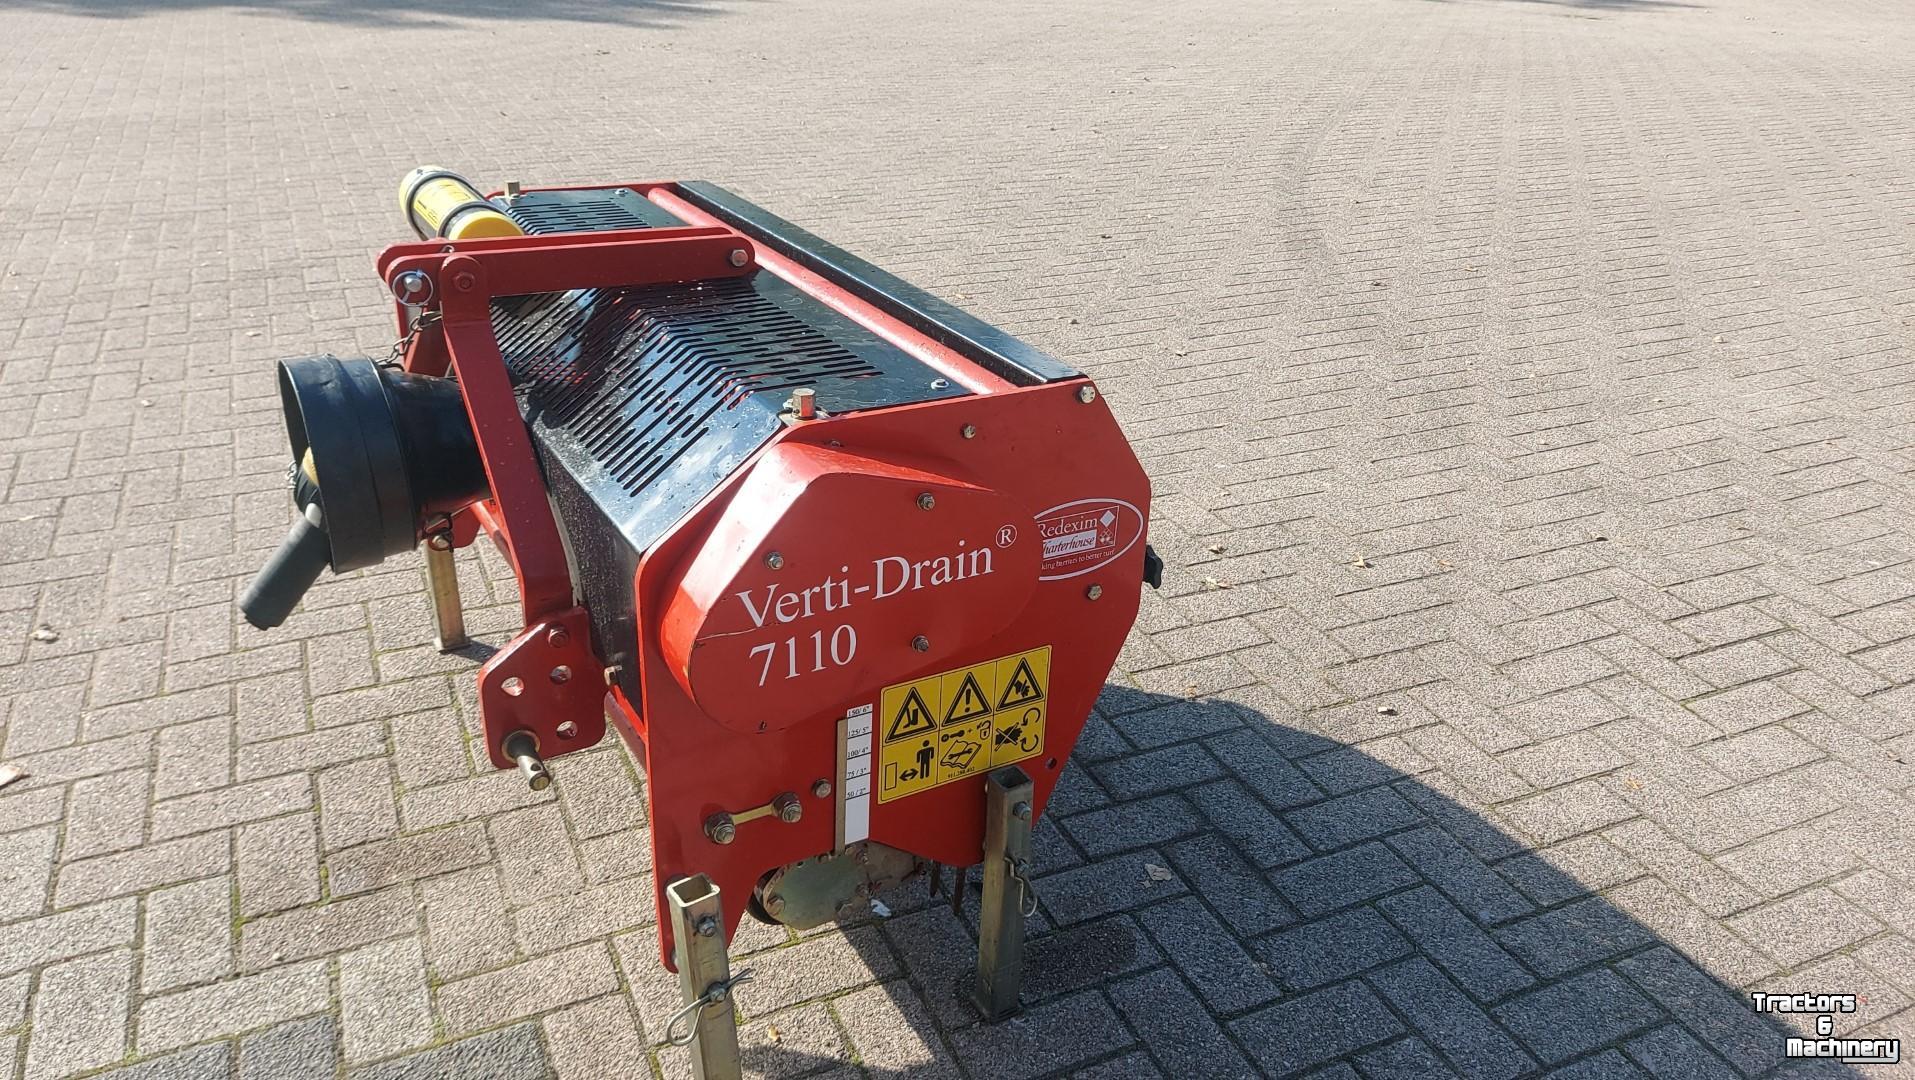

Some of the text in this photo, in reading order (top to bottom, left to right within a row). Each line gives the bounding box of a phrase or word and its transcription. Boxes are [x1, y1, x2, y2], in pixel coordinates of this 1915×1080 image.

[1038, 516, 1097, 538] Redexim
[1043, 535, 1095, 555] harterhouse
[1041, 561, 1055, 570] king
[749, 624, 857, 687] 7110
